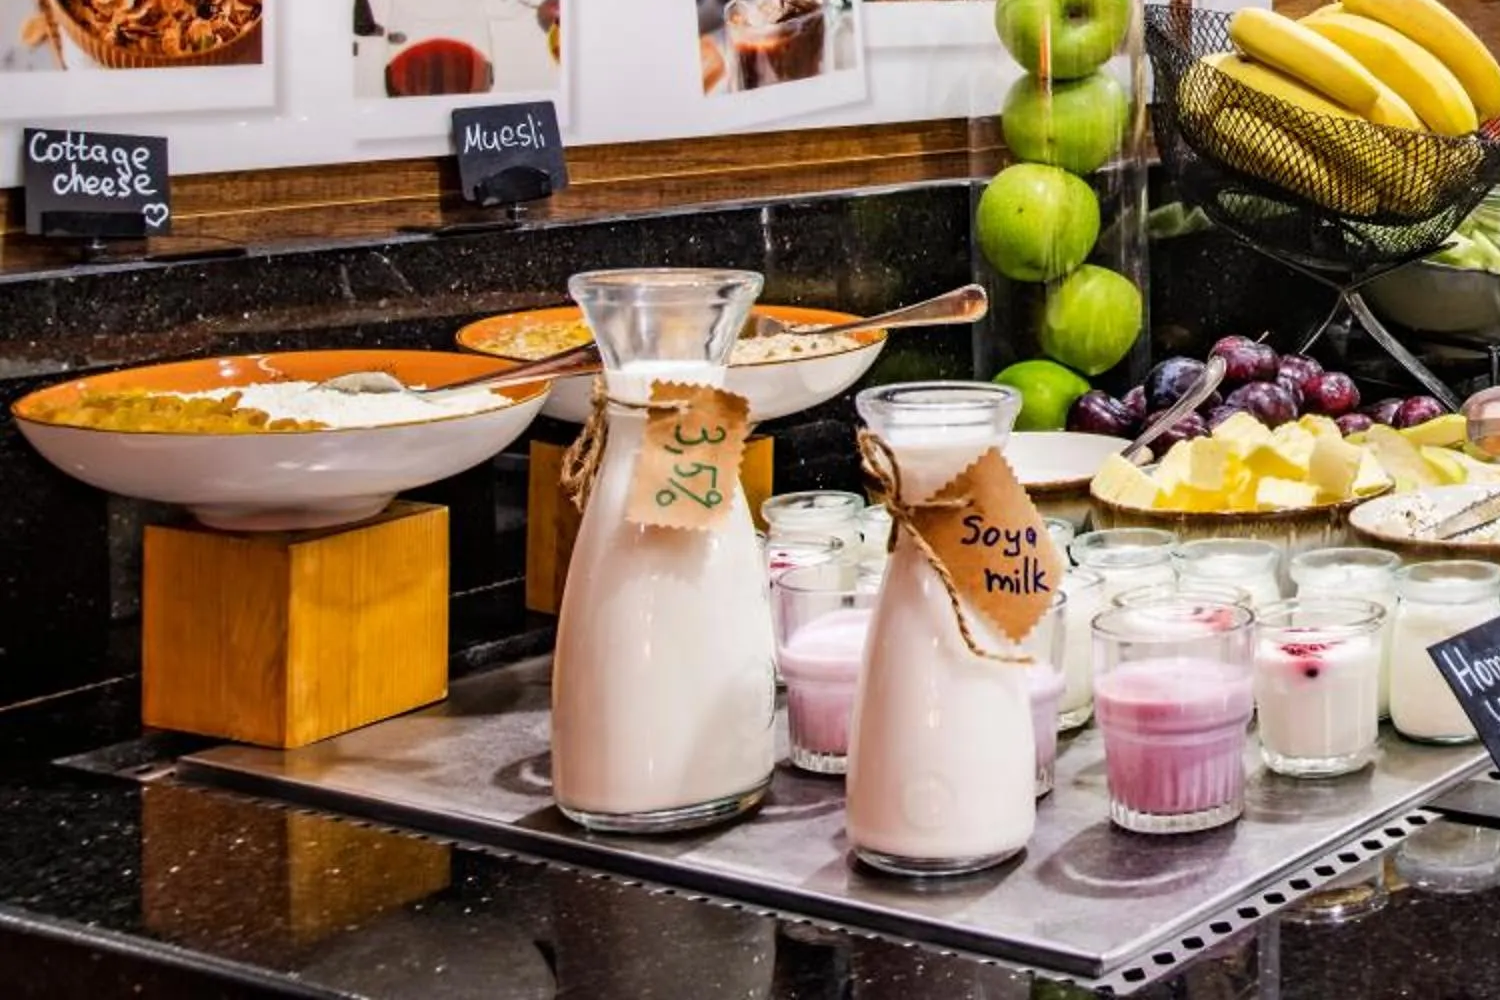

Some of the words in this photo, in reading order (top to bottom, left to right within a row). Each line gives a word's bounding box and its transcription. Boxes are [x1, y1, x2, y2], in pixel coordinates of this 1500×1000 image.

[29, 131, 151, 172] Cottage
[463, 114, 547, 154] Muesli
[53, 168, 158, 198] cheese
[961, 515, 1038, 557] Soya
[983, 558, 1050, 594] milk
